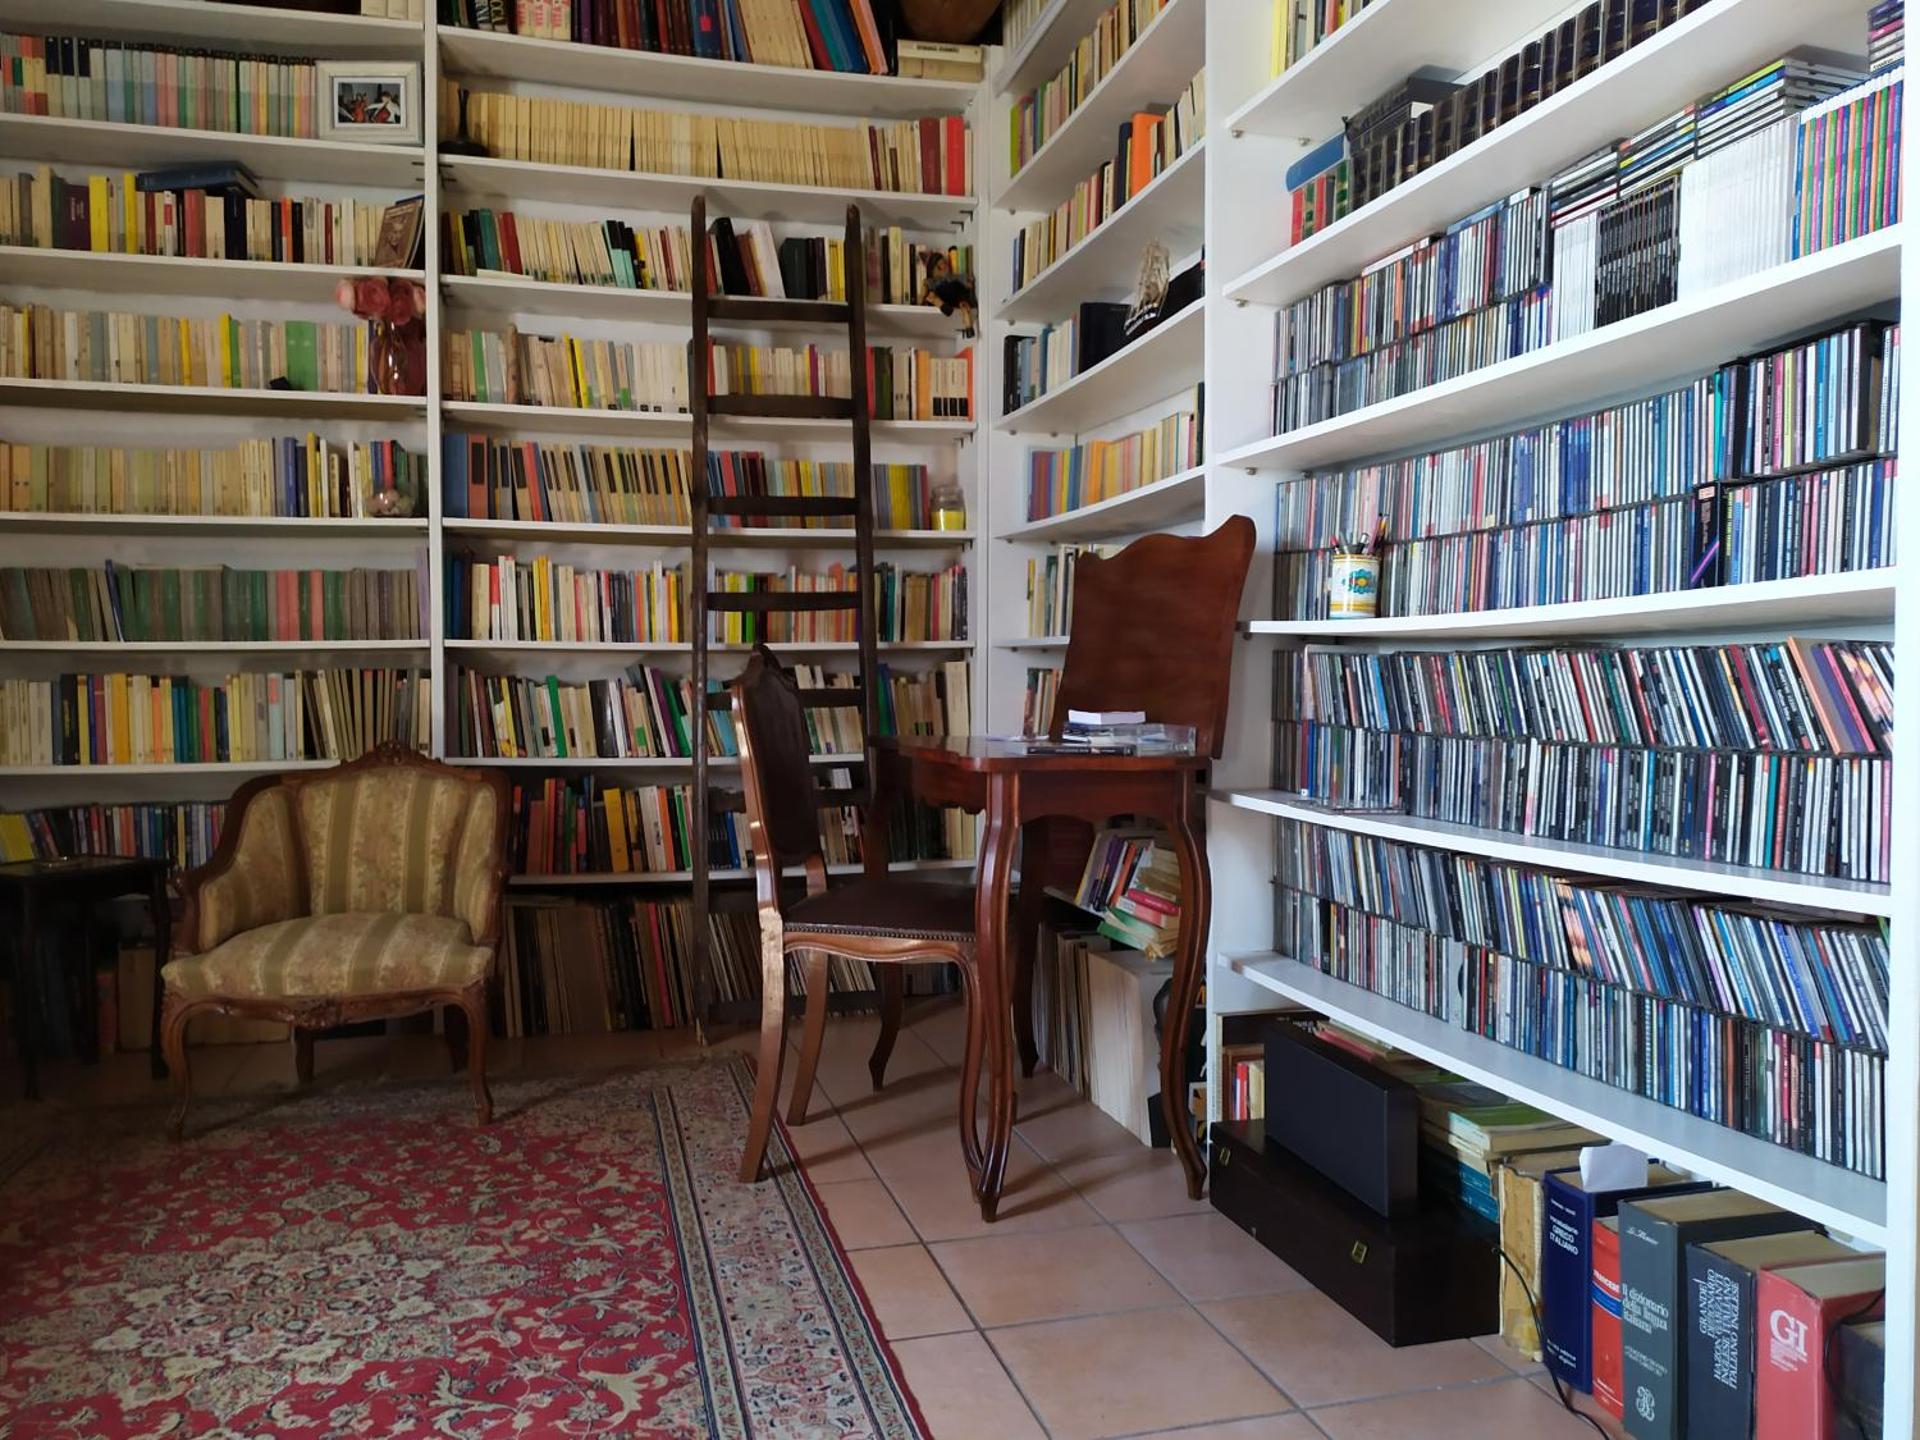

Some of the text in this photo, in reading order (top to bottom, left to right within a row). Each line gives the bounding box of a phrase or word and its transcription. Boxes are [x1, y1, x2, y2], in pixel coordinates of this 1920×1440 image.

[1549, 1232, 1579, 1255] ITALIANO
[1628, 1287, 1669, 1319] dizionario
[1699, 1282, 1707, 1334] GRANDE
[1706, 1269, 1716, 1339] DIZIONARIO
[1713, 1272, 1724, 1380] HAZON GARZANTI
[1721, 1277, 1731, 1385] INGLESE ITALIANO
[1729, 1280, 1740, 1390] ITALIANO INGLESE
